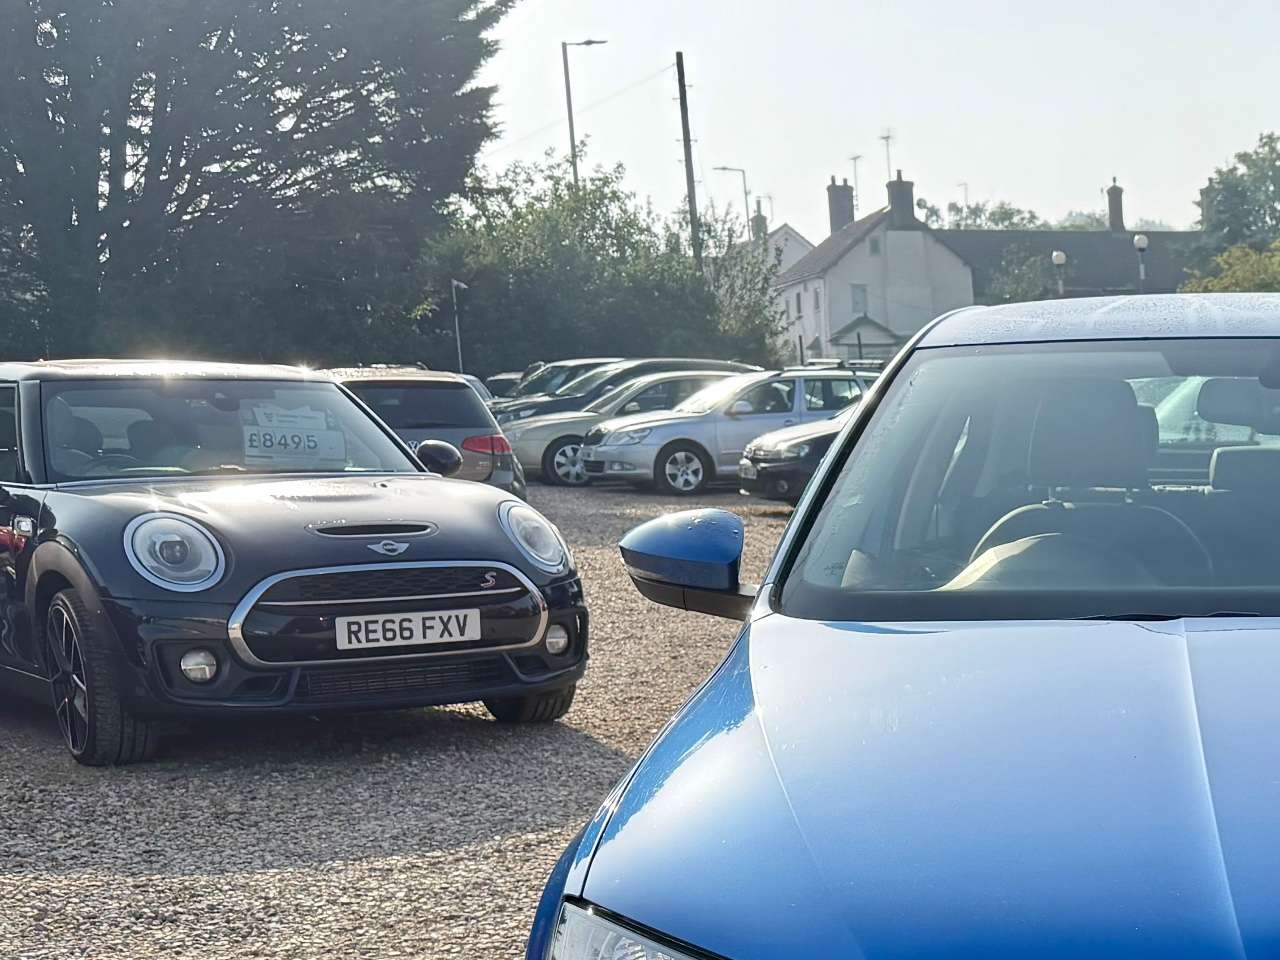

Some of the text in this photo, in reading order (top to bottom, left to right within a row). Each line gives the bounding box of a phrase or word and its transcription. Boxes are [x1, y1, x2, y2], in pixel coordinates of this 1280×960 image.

[248, 432, 318, 450] £8495
[346, 614, 468, 645] RE66 FXV
